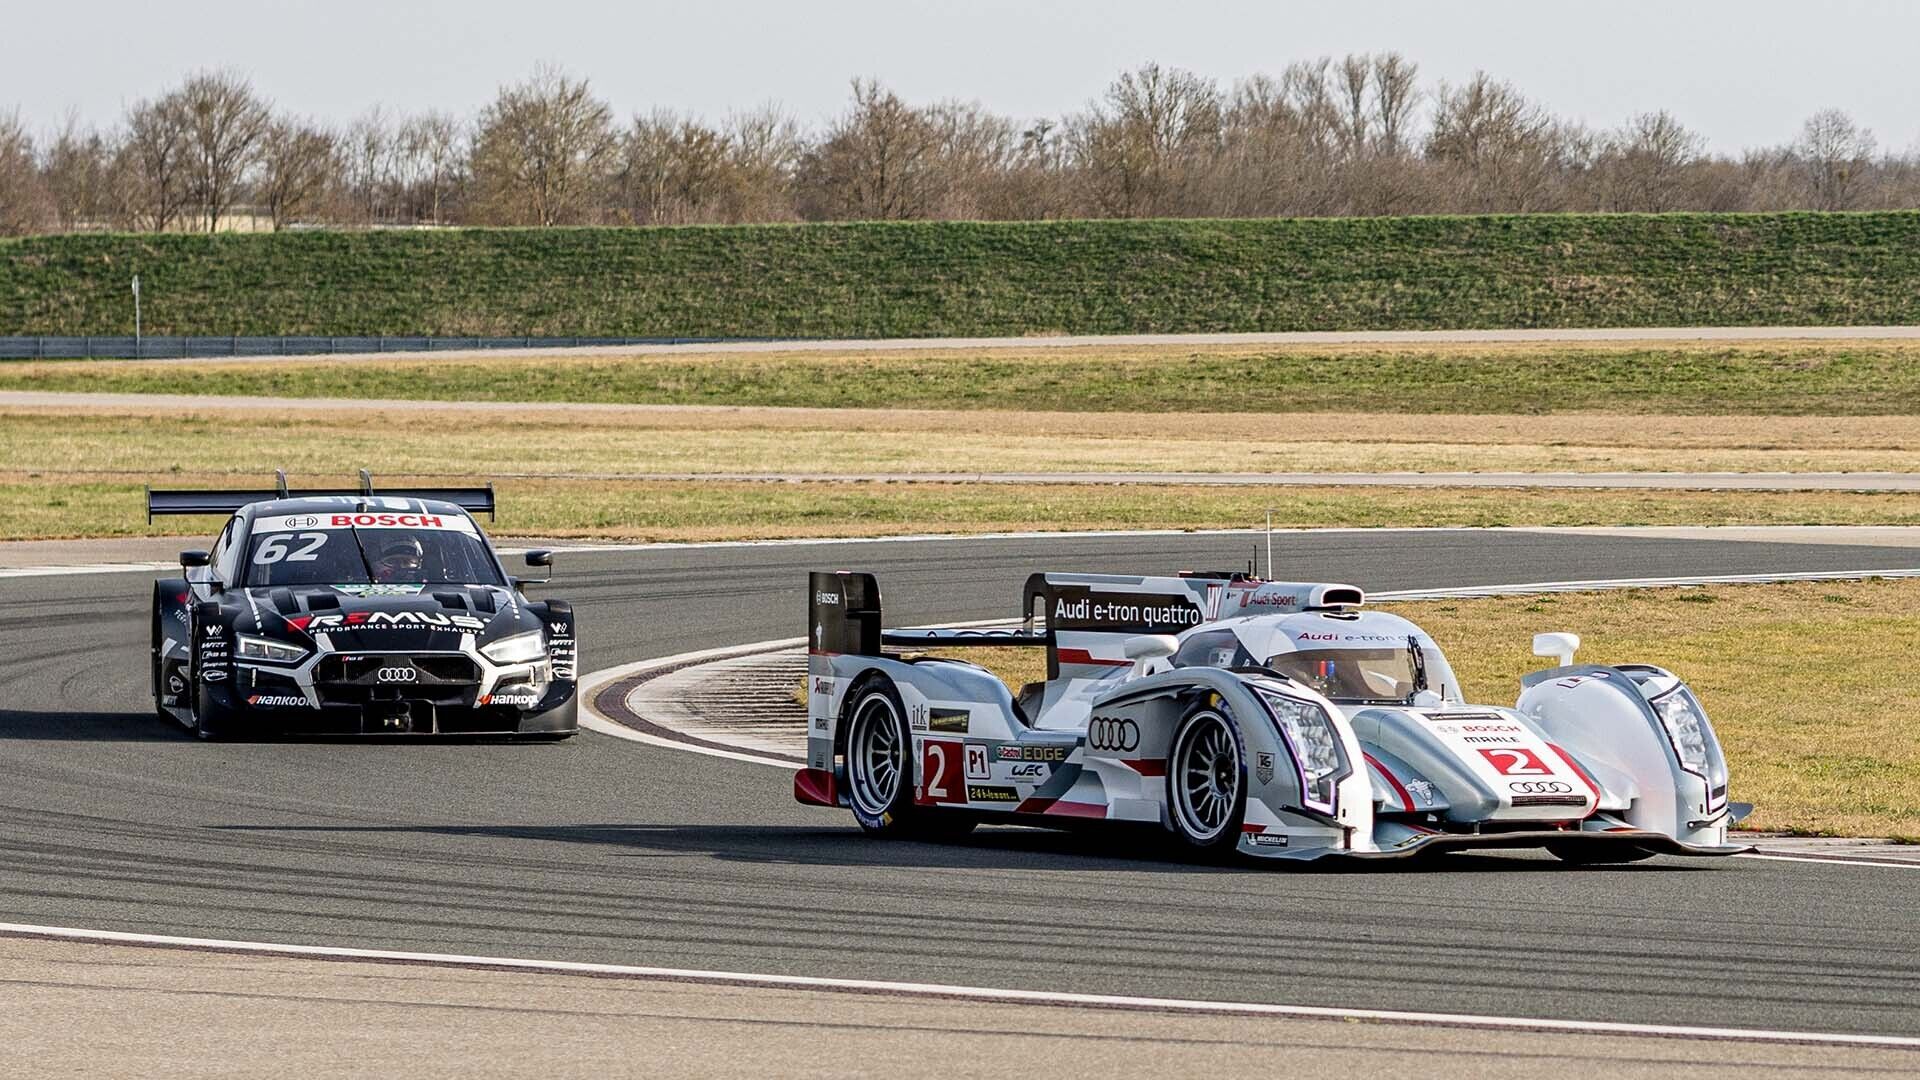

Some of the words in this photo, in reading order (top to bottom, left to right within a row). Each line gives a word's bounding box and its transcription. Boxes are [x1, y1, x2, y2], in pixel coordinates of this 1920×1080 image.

[331, 515, 443, 527] BOSCH
[253, 532, 329, 565] 62
[821, 592, 839, 604] BOSCH
[1249, 593, 1269, 605] Audi
[1271, 594, 1296, 608] Sport
[1055, 598, 1090, 620] Audi
[1094, 602, 1139, 622] e-tron
[1143, 604, 1199, 627] quattro
[308, 611, 485, 629] REMUS
[309, 624, 388, 634] PERFORMANCE
[430, 625, 485, 635] EXHAUSTS
[1297, 632, 1339, 640] Audi
[1344, 632, 1395, 641] e-tron
[912, 704, 927, 725] itk
[1463, 725, 1522, 733] BOSCH
[1023, 747, 1065, 760] EDGE
[969, 750, 986, 774] P1
[1491, 750, 1545, 774] 2
[928, 744, 948, 798] 2
[1011, 764, 1044, 776] WEC
[1257, 835, 1287, 843] MICHELIN
